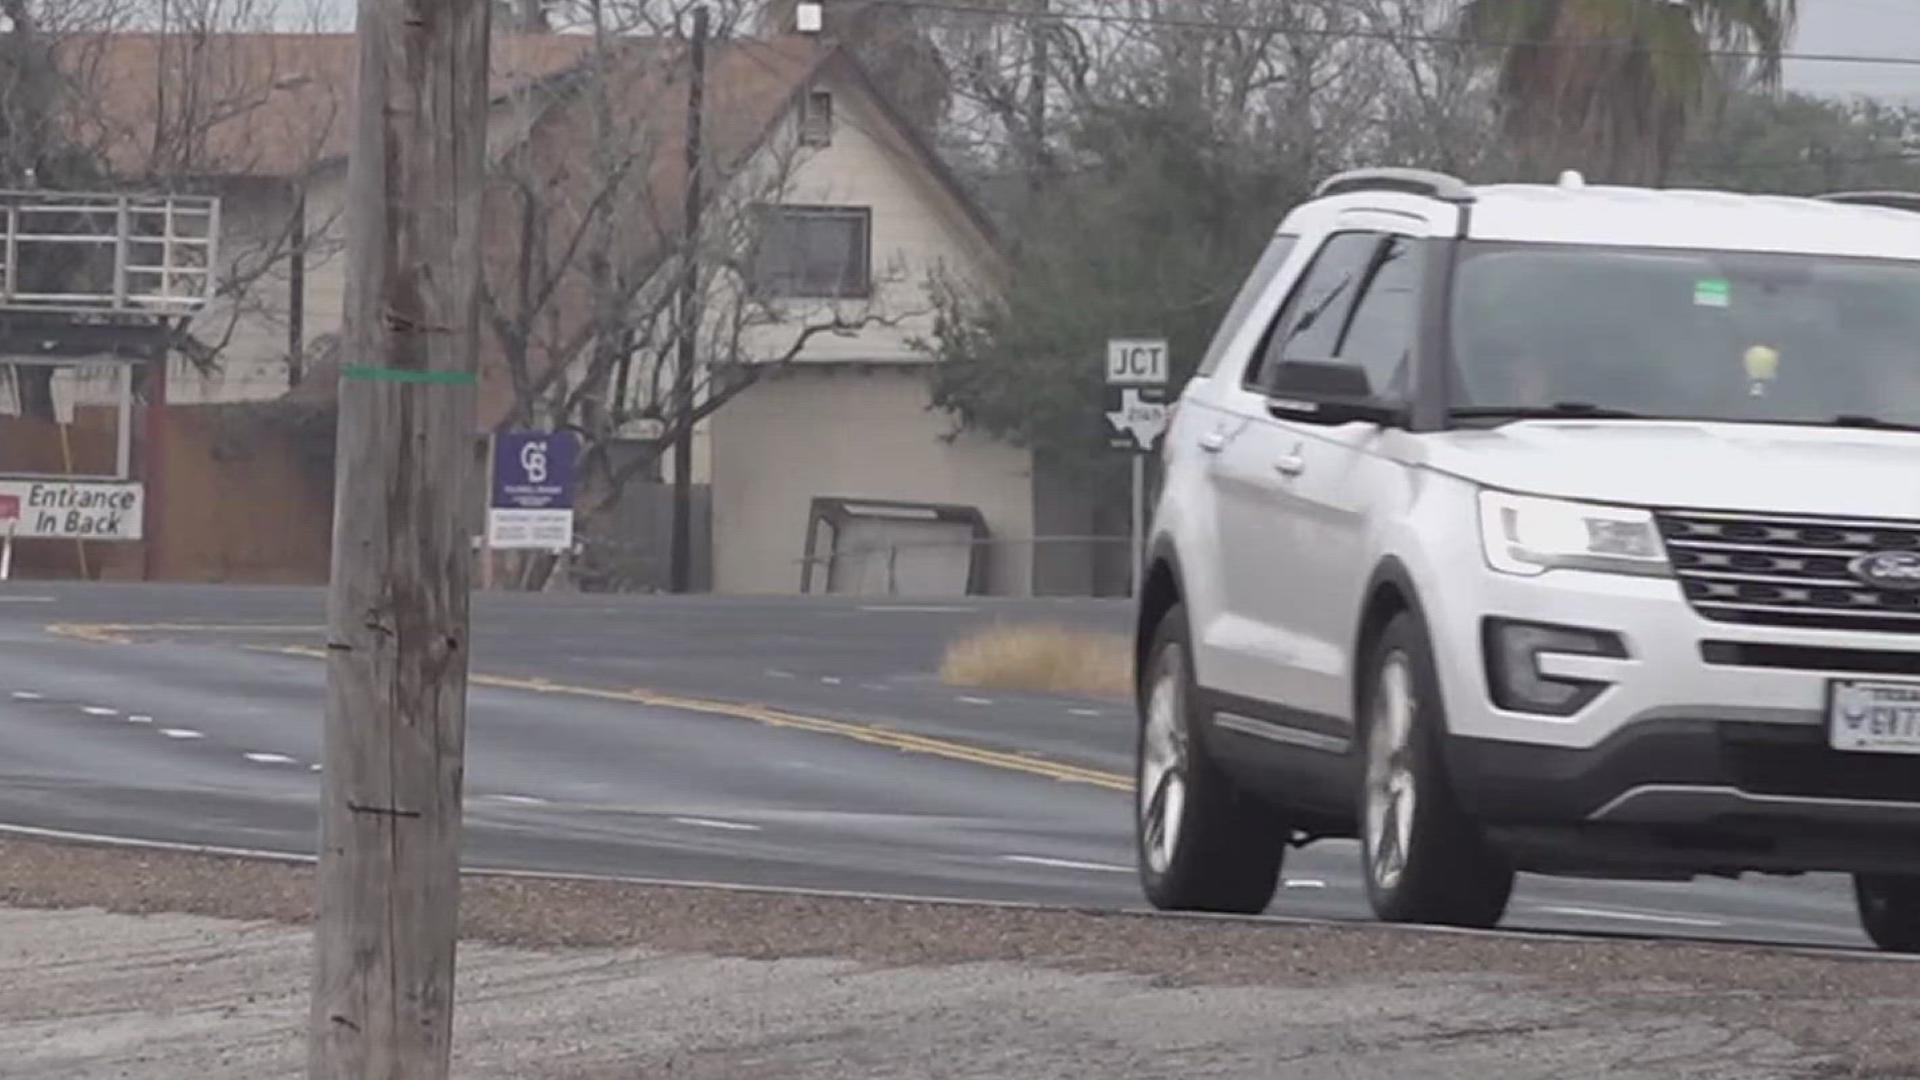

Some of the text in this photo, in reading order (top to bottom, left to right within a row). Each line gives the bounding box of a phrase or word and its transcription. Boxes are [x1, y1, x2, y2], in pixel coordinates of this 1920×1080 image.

[1113, 348, 1162, 375] JCT
[28, 484, 135, 510] Entrance
[36, 509, 120, 534] In Back
